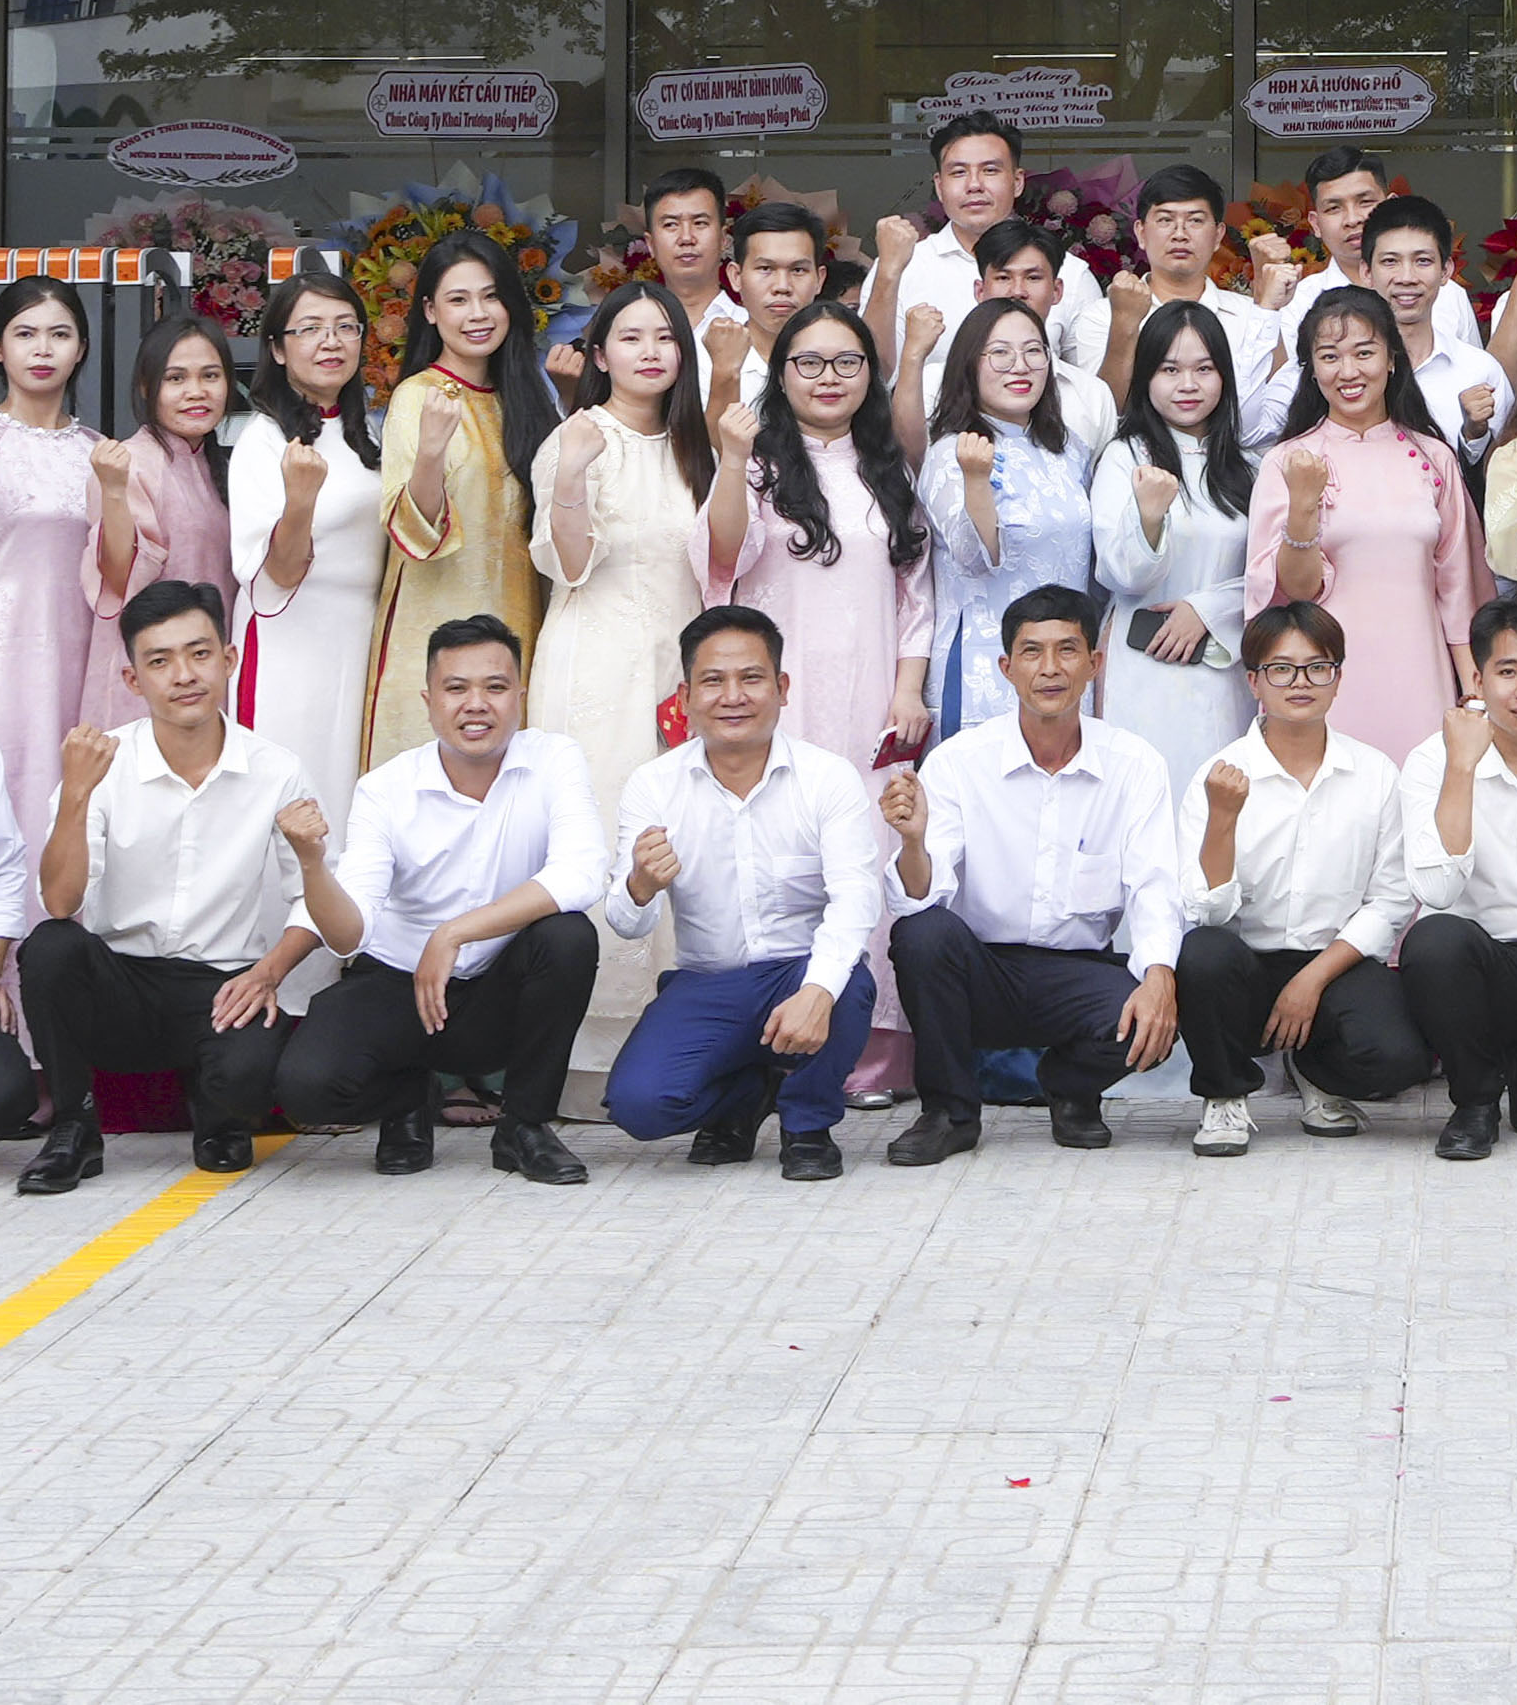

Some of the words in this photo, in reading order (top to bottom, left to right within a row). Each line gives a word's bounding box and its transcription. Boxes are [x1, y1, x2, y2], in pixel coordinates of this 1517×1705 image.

[389, 78, 415, 102] NHÀ
[419, 79, 447, 102] MÁY
[449, 75, 475, 102] KẾT
[478, 76, 501, 102] CẤU
[504, 80, 537, 102] THÉP
